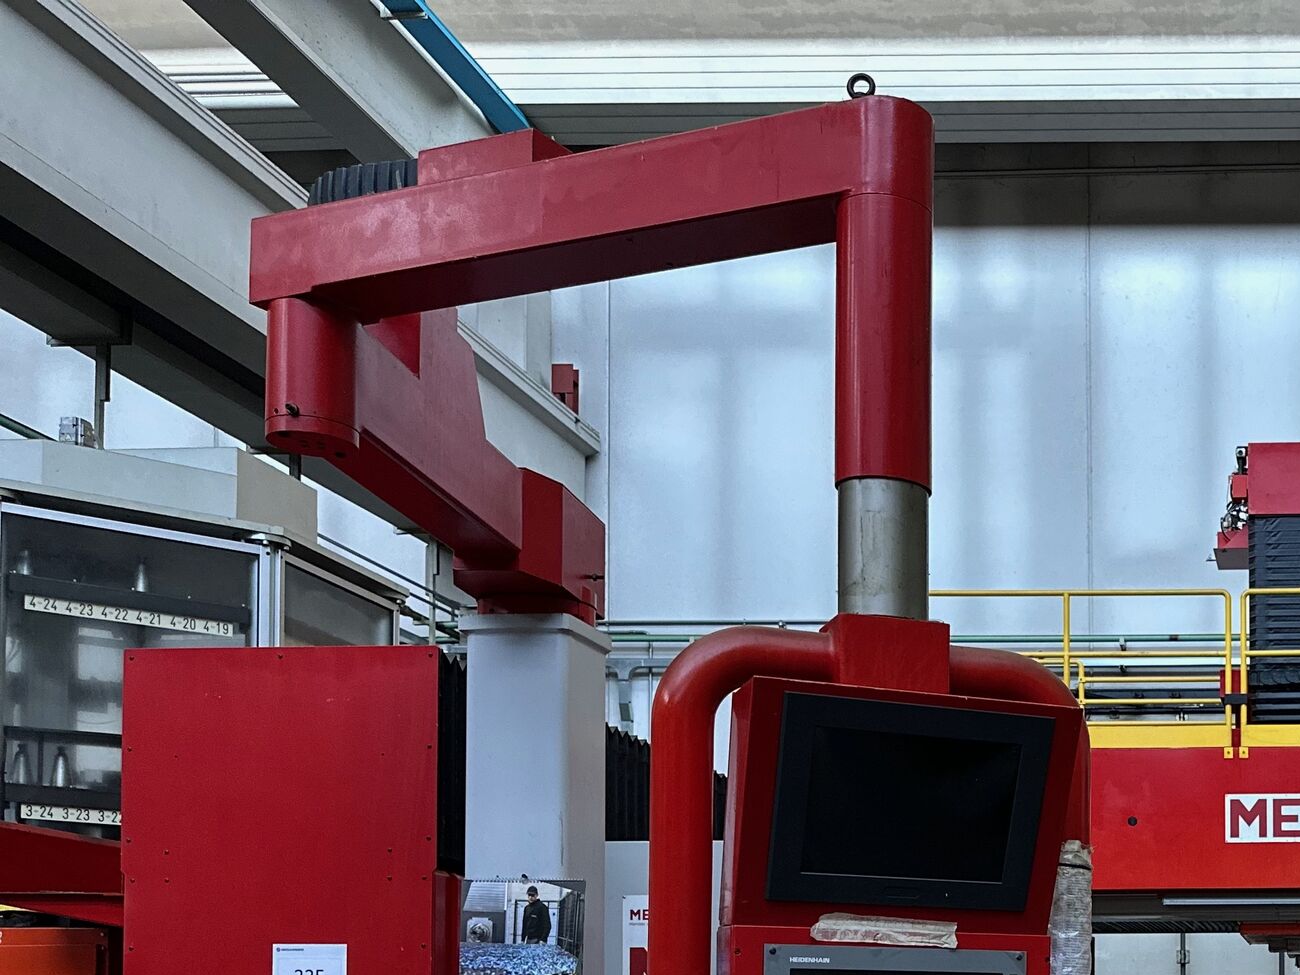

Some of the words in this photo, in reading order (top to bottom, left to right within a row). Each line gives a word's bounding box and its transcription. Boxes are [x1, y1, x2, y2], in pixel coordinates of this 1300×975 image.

[29, 595, 57, 611] 4-24
[65, 601, 93, 616] 4-23
[101, 606, 129, 621] 4-22
[136, 611, 161, 626] 4-21
[170, 616, 197, 631] 4-20
[203, 620, 229, 635] 4-19
[25, 804, 53, 819] 3-24
[62, 807, 90, 821] 3-23
[98, 810, 122, 824] 3-2
